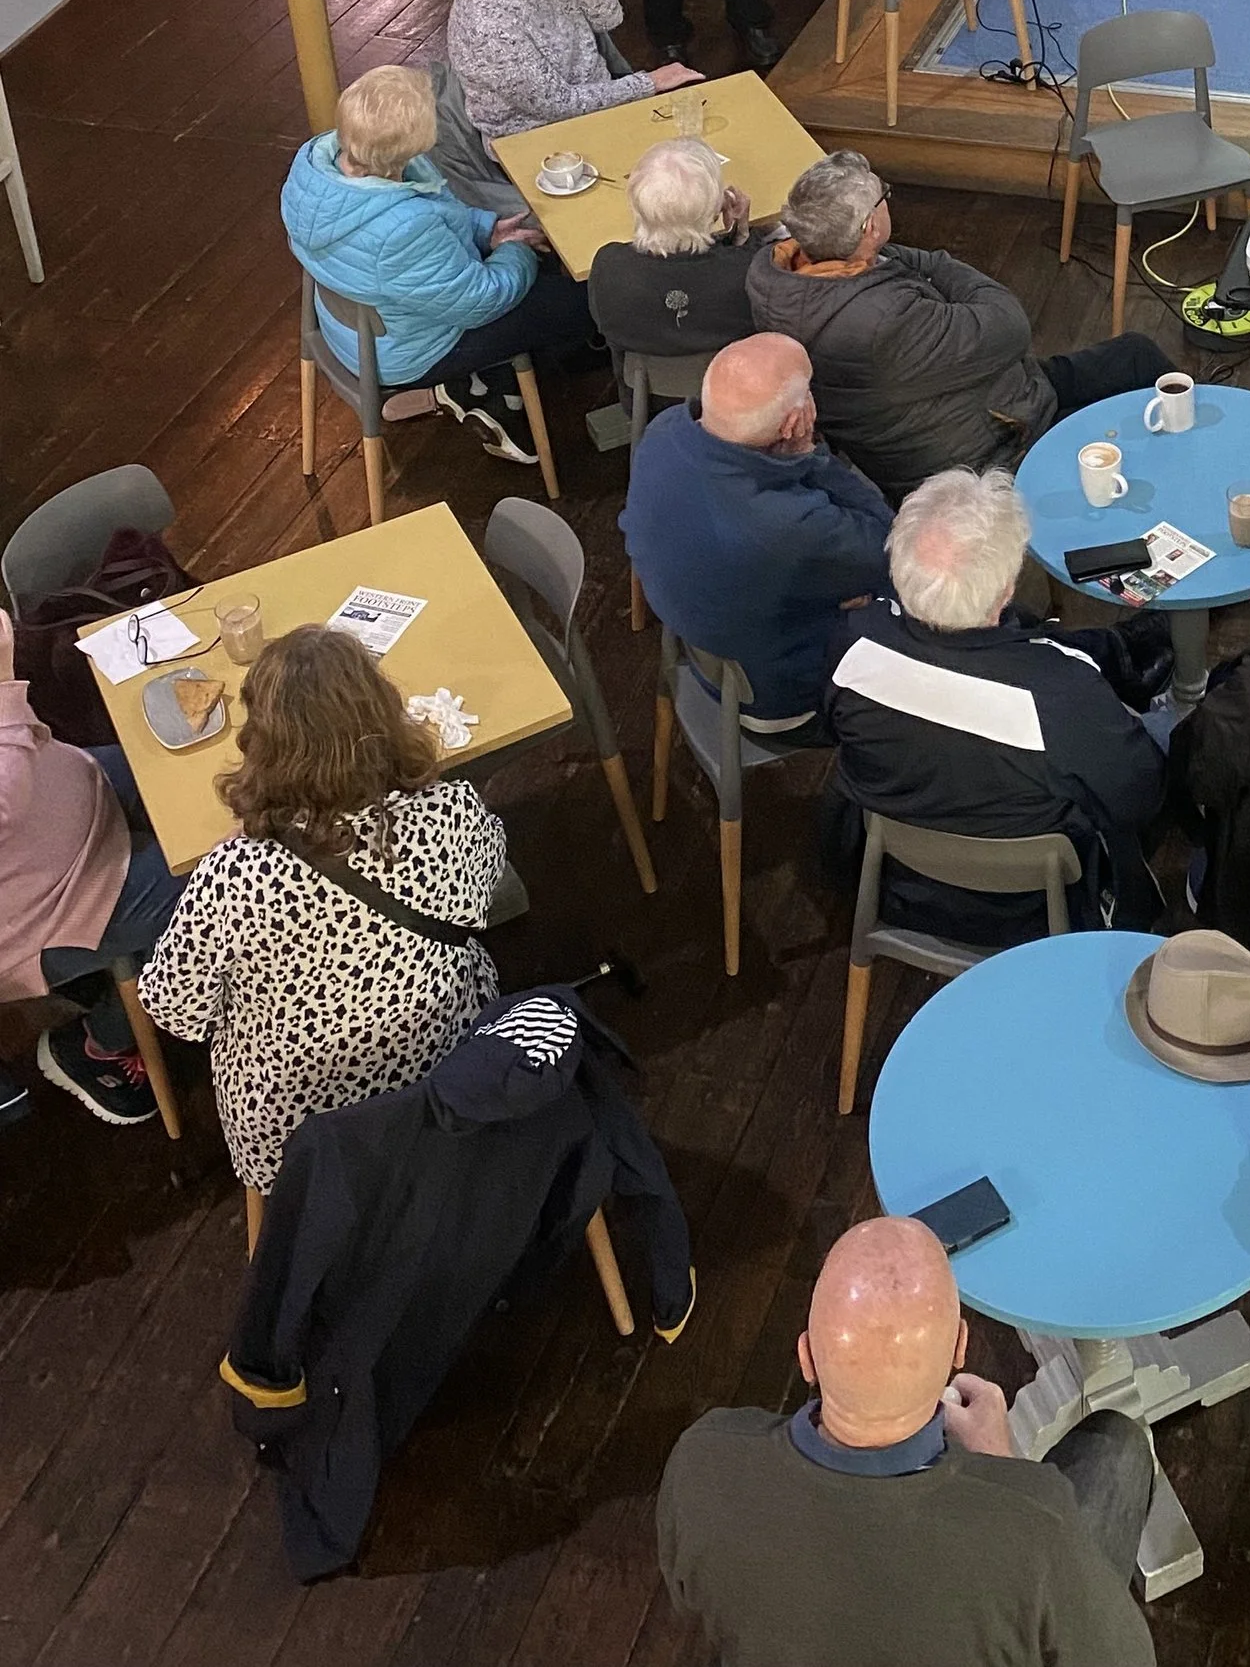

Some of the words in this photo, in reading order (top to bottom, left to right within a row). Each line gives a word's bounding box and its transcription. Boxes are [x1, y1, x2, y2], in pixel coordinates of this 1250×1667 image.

[353, 594, 416, 614] FOOTSTEPS
[359, 590, 394, 602] WESTERN
[394, 598, 422, 607] FRONT
